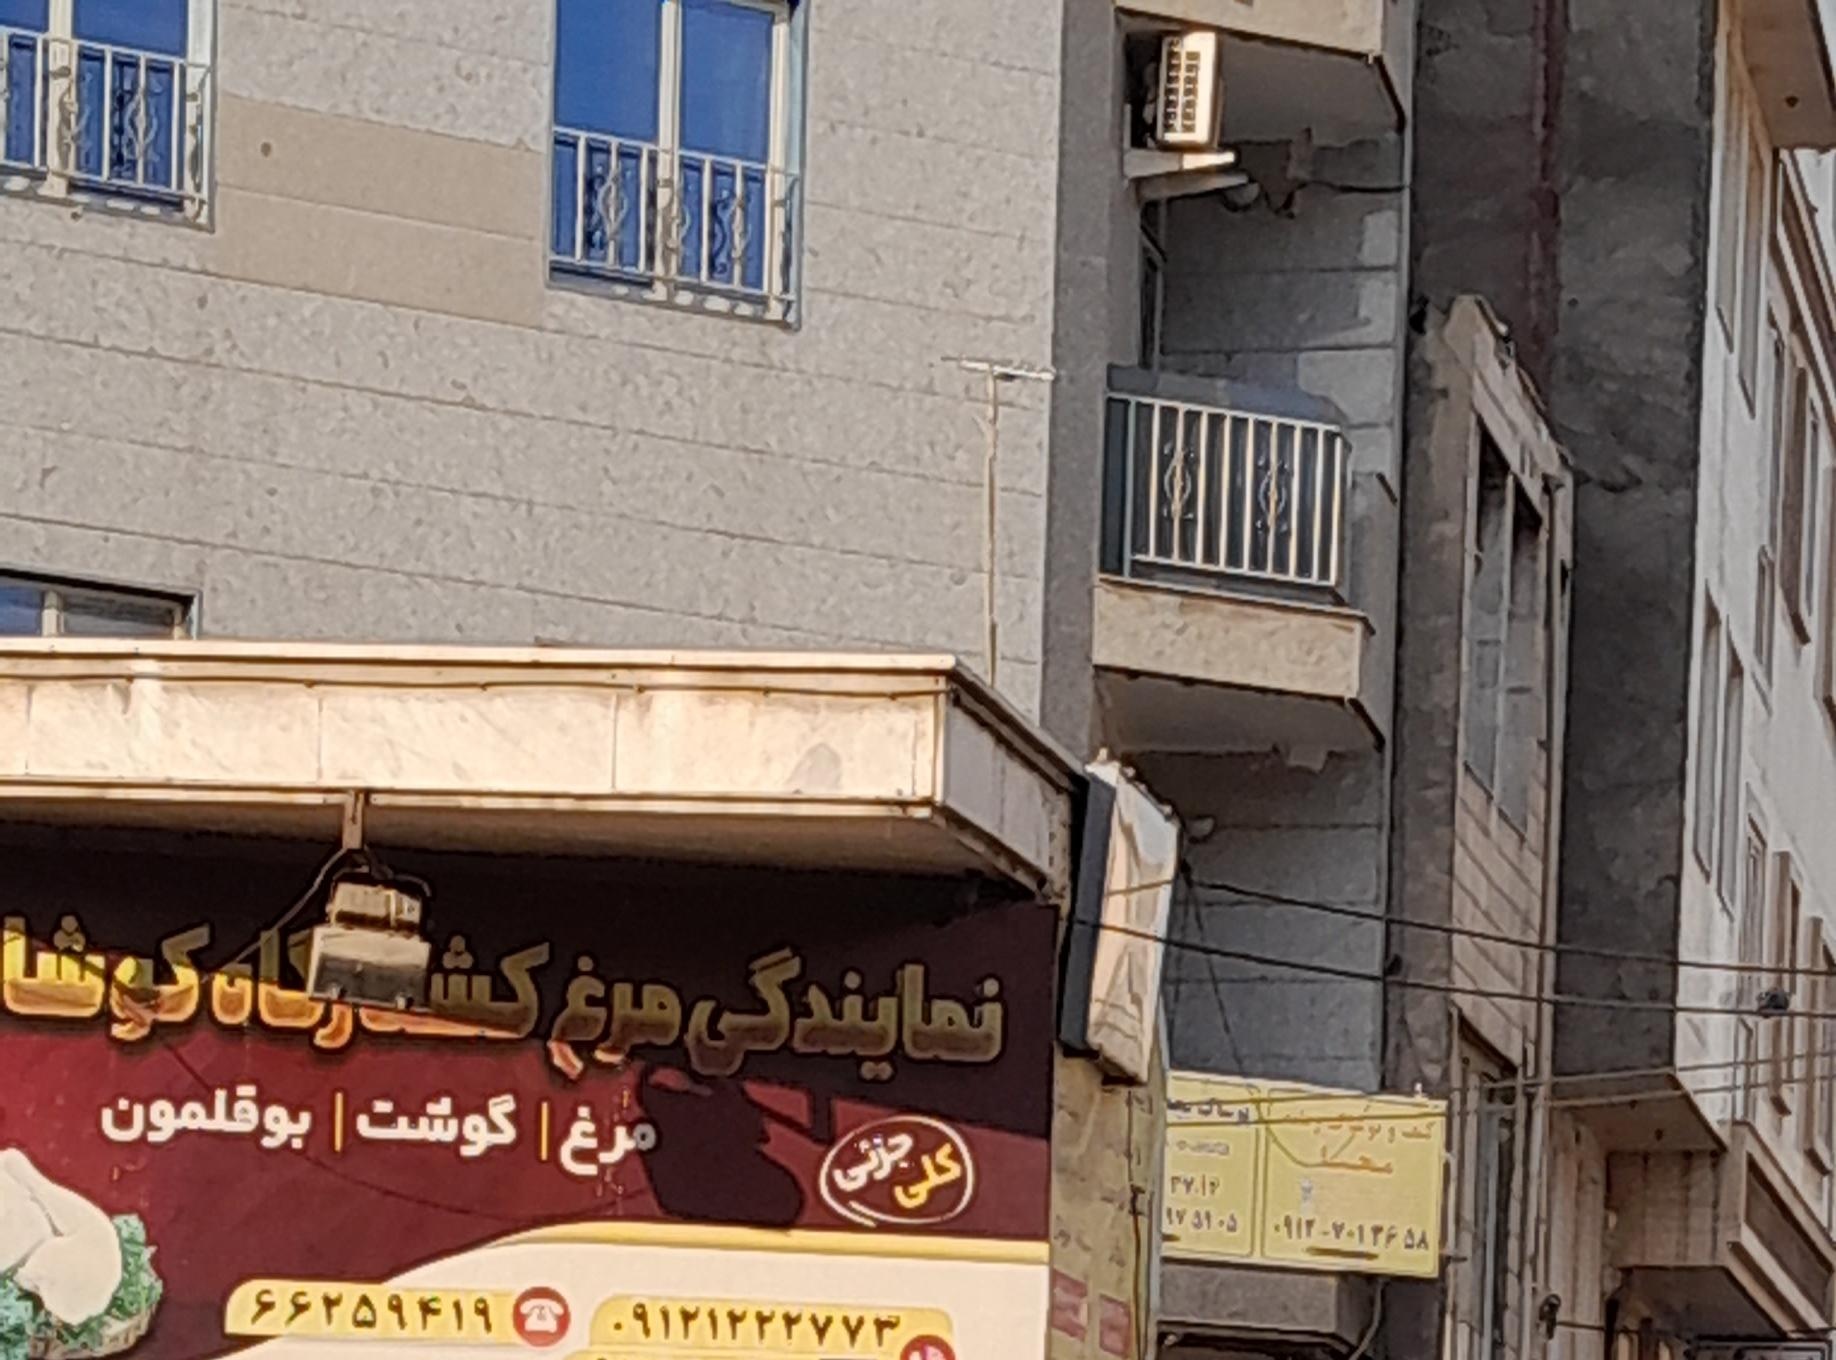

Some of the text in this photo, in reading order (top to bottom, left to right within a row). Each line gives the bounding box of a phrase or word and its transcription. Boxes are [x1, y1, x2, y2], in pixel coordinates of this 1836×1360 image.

[212, 926, 550, 1049] کشرگاه
[548, 956, 682, 1079] مرغ
[686, 948, 1004, 1079] نمایندگی
[101, 1085, 656, 1176] مرغ گوشت بوقلمون
[833, 1133, 914, 1192] جزئی
[894, 1143, 961, 1208] کلی
[250, 1289, 493, 1333] ۶۶۲۵۹۴۱۹
[613, 1302, 901, 1347] ۰۹۱۲۱۲۲۲۷۷۳
